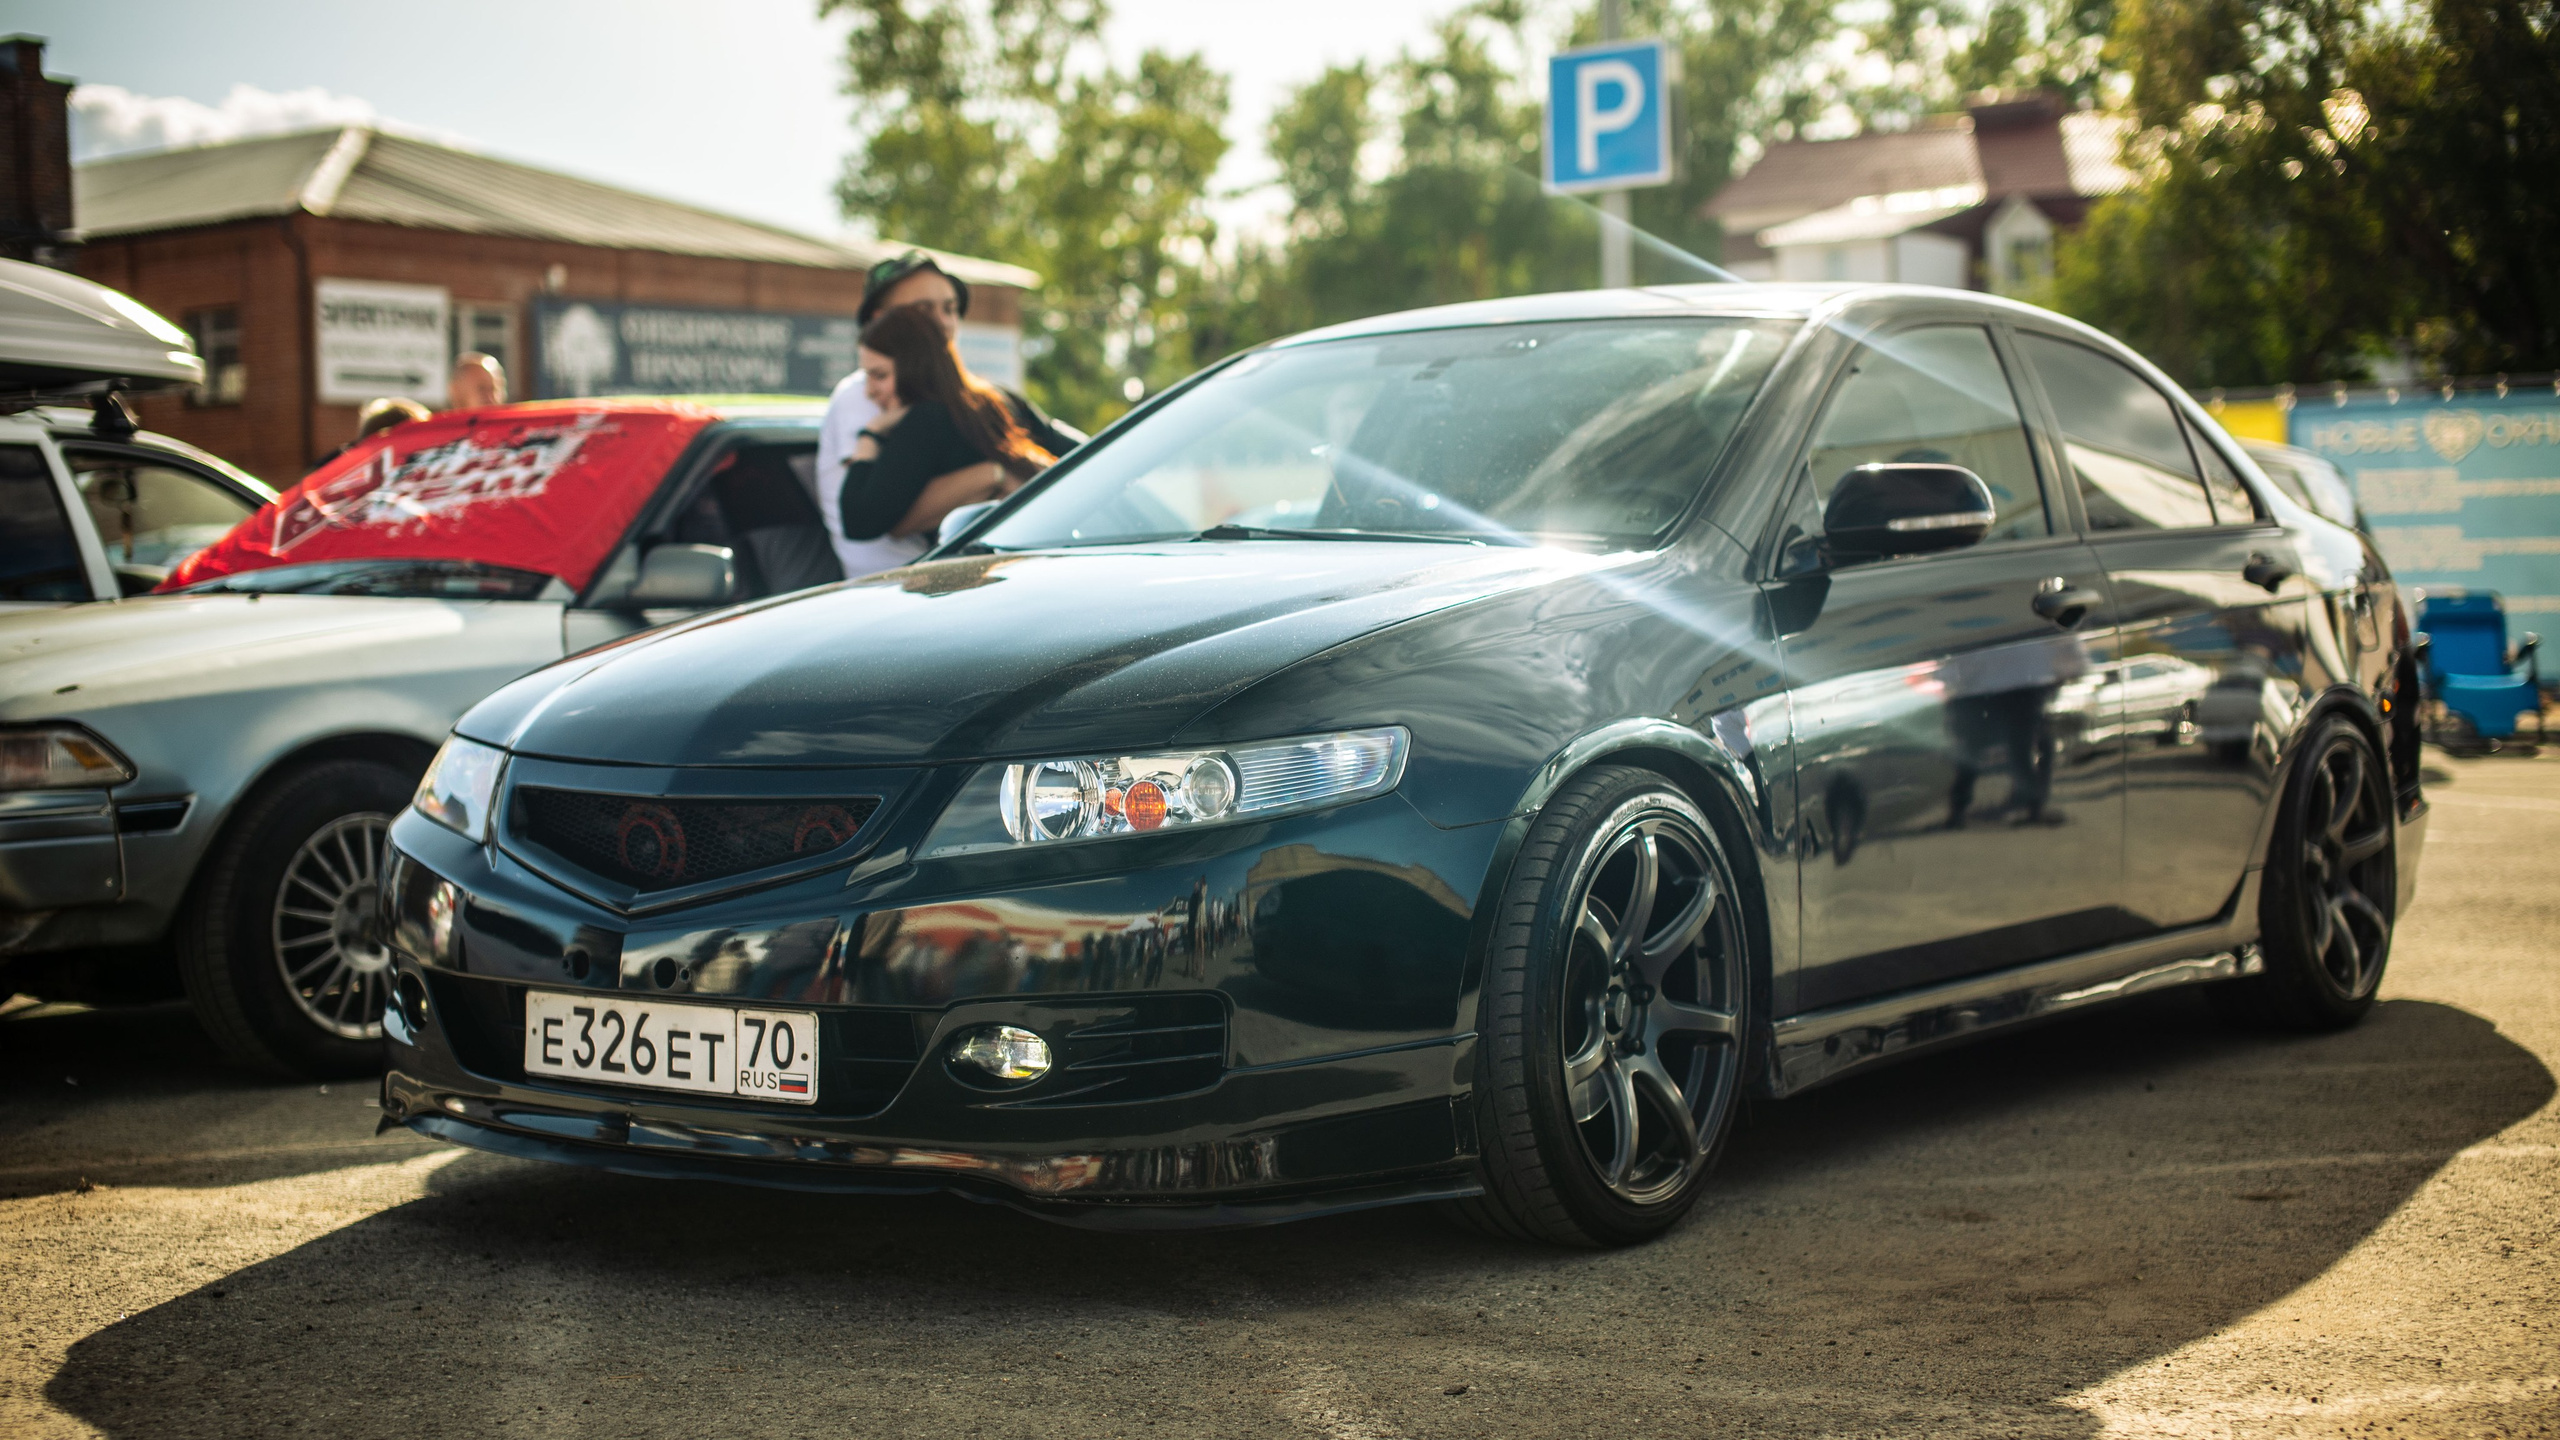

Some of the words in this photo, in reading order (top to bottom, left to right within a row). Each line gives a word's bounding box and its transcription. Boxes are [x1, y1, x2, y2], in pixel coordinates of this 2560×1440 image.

[1575, 59, 1645, 174] P
[2311, 418, 2421, 455] НОВЫЕ
[543, 1006, 725, 1083] E326ET
[744, 1018, 795, 1070] 70
[740, 1070, 777, 1090] RUS
